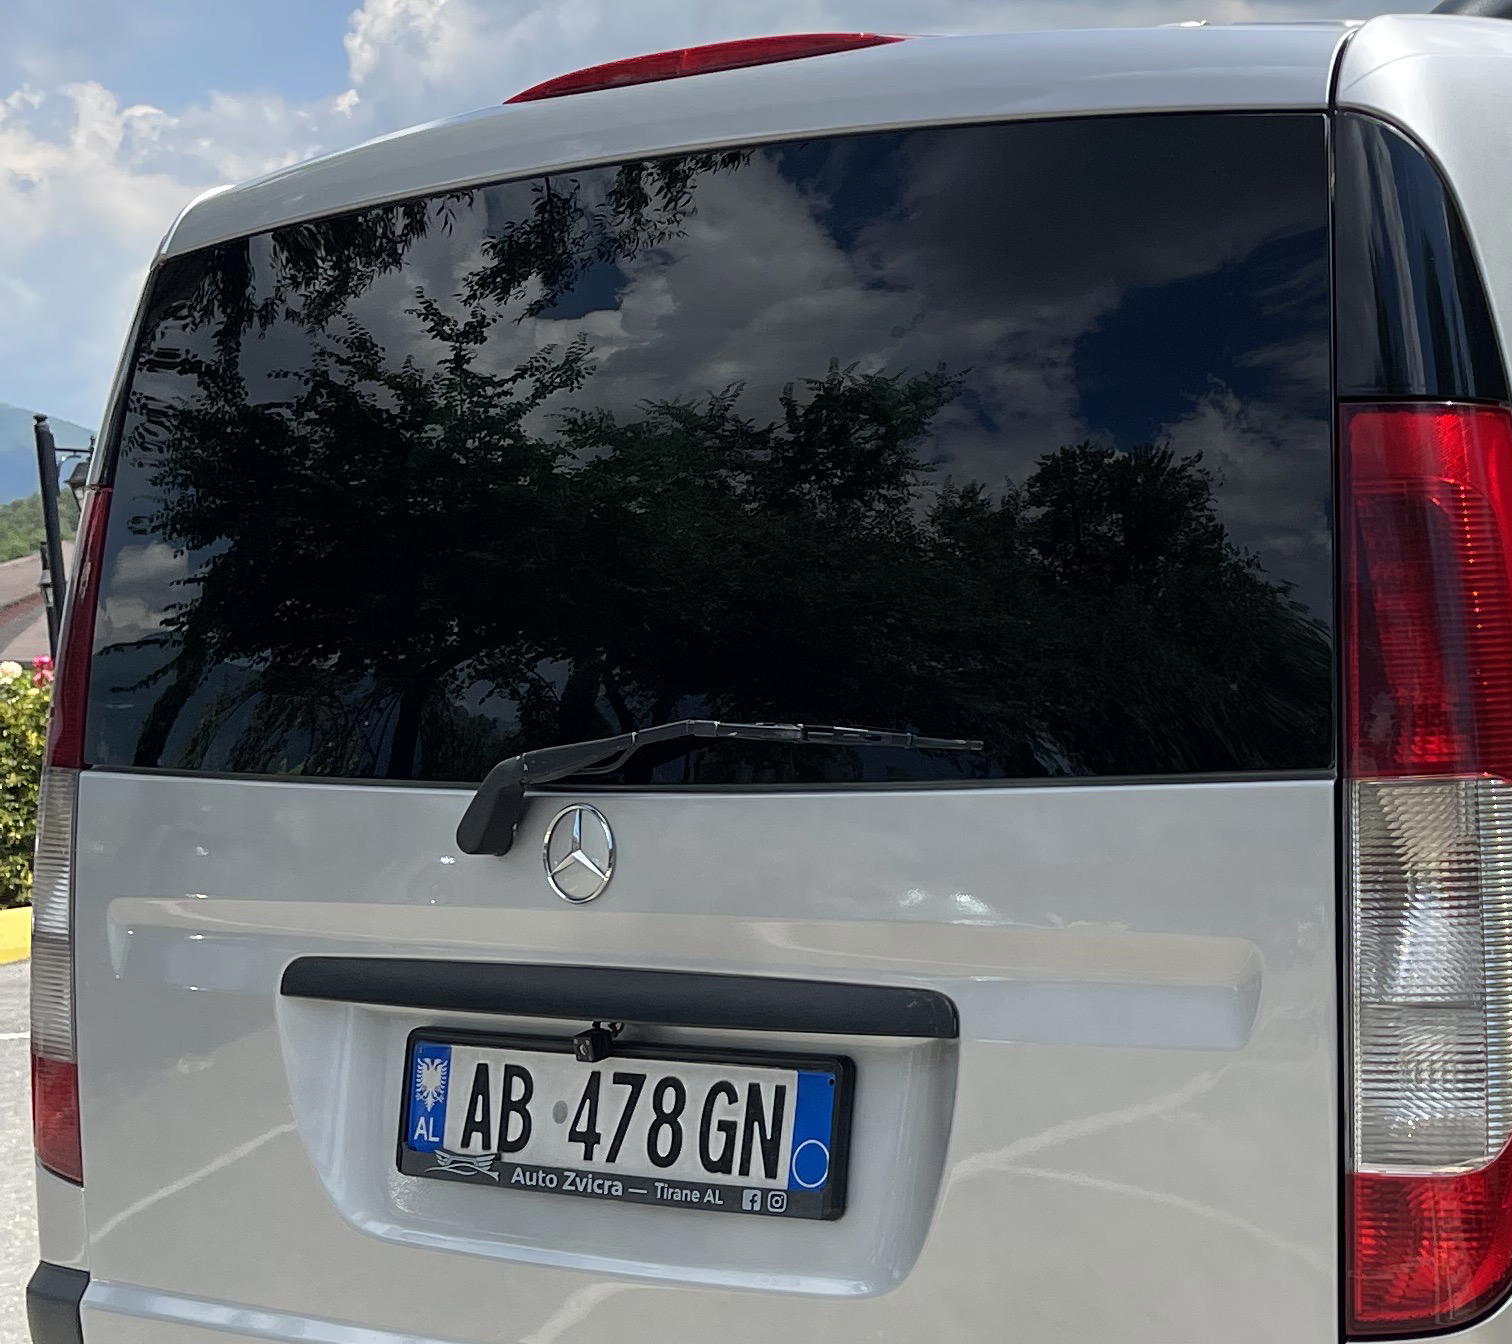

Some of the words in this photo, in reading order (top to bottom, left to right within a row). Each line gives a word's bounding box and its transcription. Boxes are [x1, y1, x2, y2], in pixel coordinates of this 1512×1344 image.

[460, 1062, 534, 1154] AB
[413, 1116, 441, 1142] AL
[510, 1166, 558, 1189] Auto
[562, 1171, 623, 1197] Zvicra
[654, 1181, 701, 1203] Tirane
[703, 1188, 724, 1205] AL
